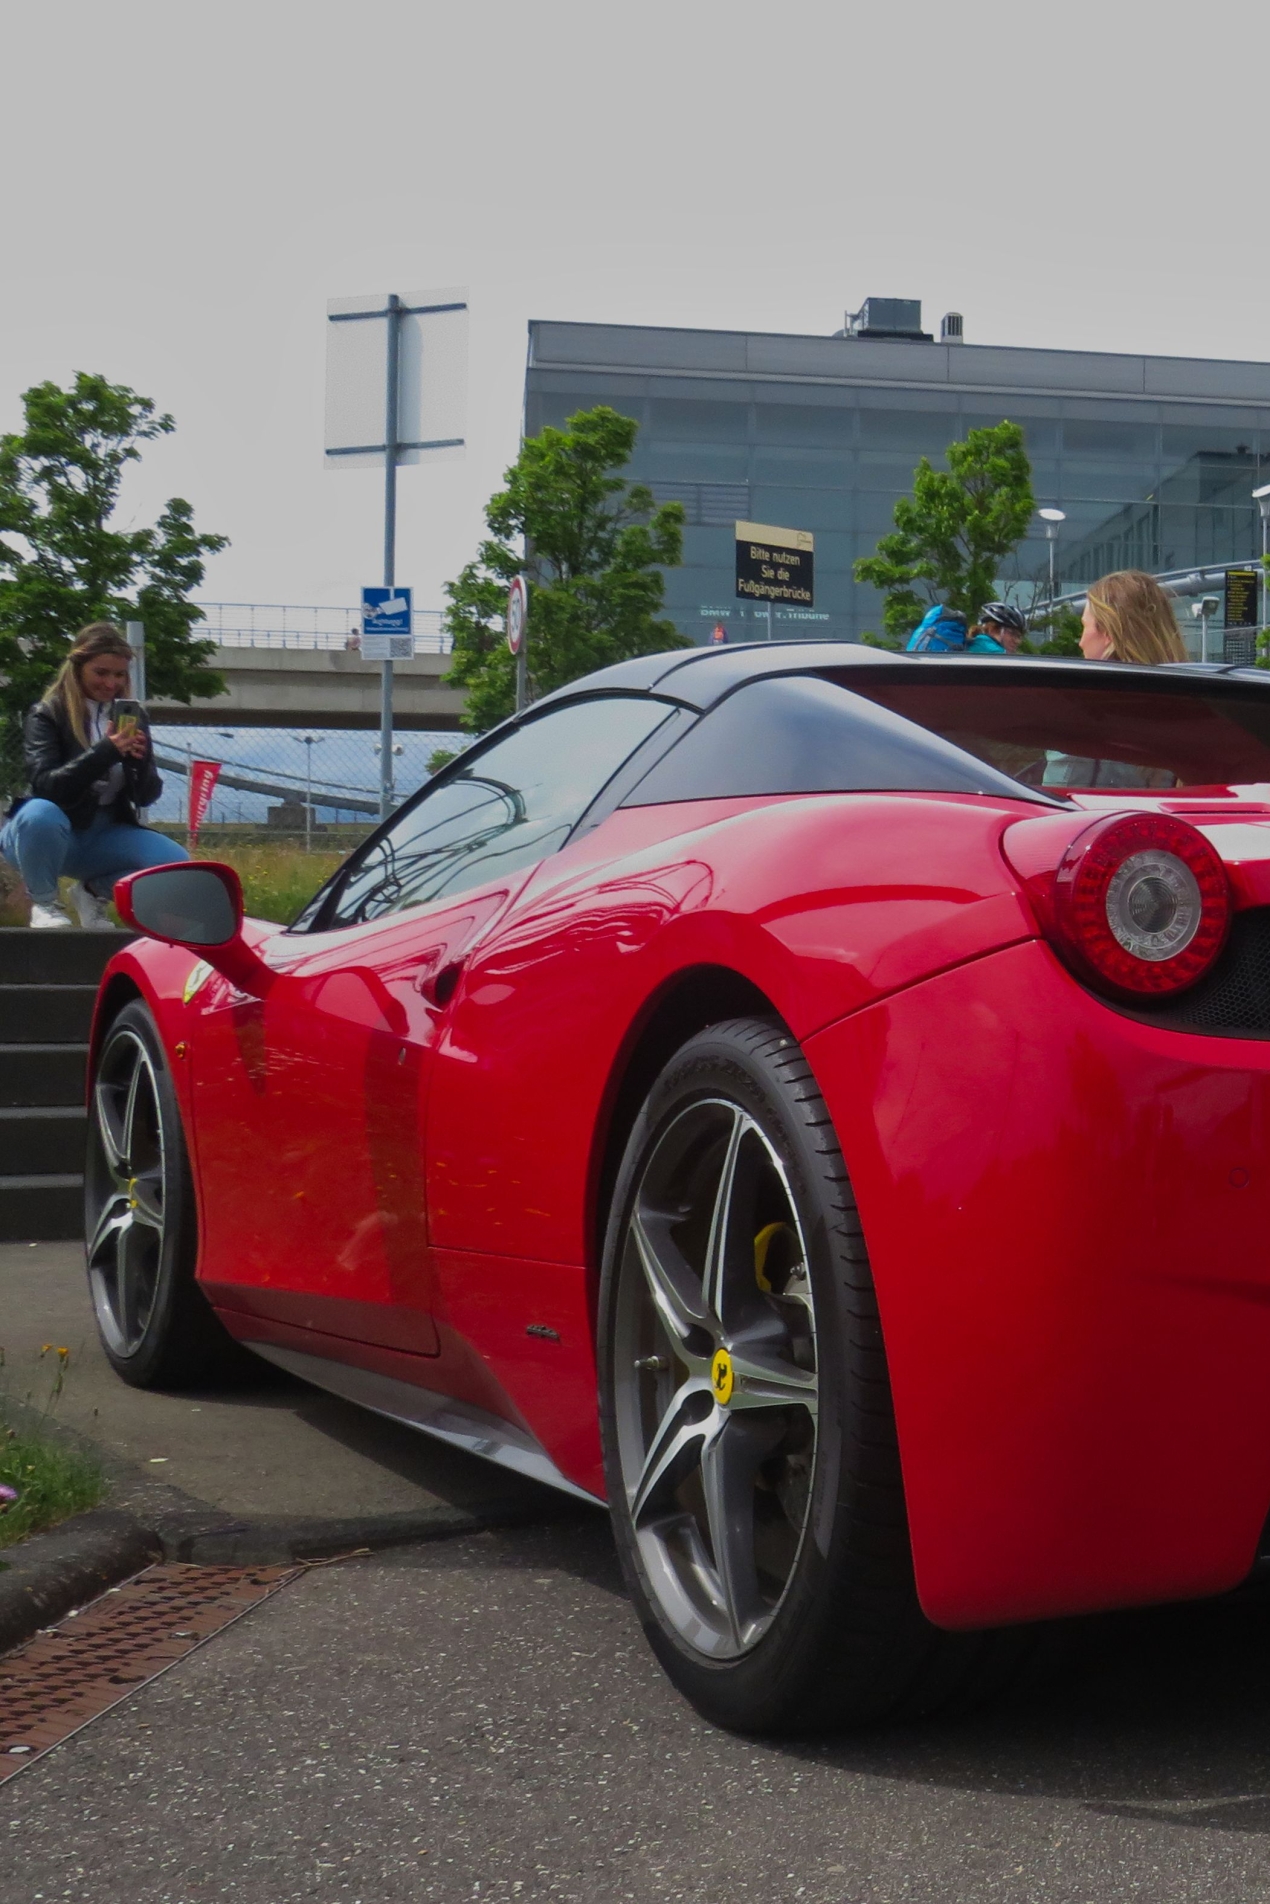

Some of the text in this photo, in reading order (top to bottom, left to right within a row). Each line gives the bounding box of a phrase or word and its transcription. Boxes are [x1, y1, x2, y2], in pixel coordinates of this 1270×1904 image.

[750, 545, 801, 566] Bitte nutzen
[761, 564, 791, 581] Sie die
[738, 578, 812, 601] Fußgängerbrücke
